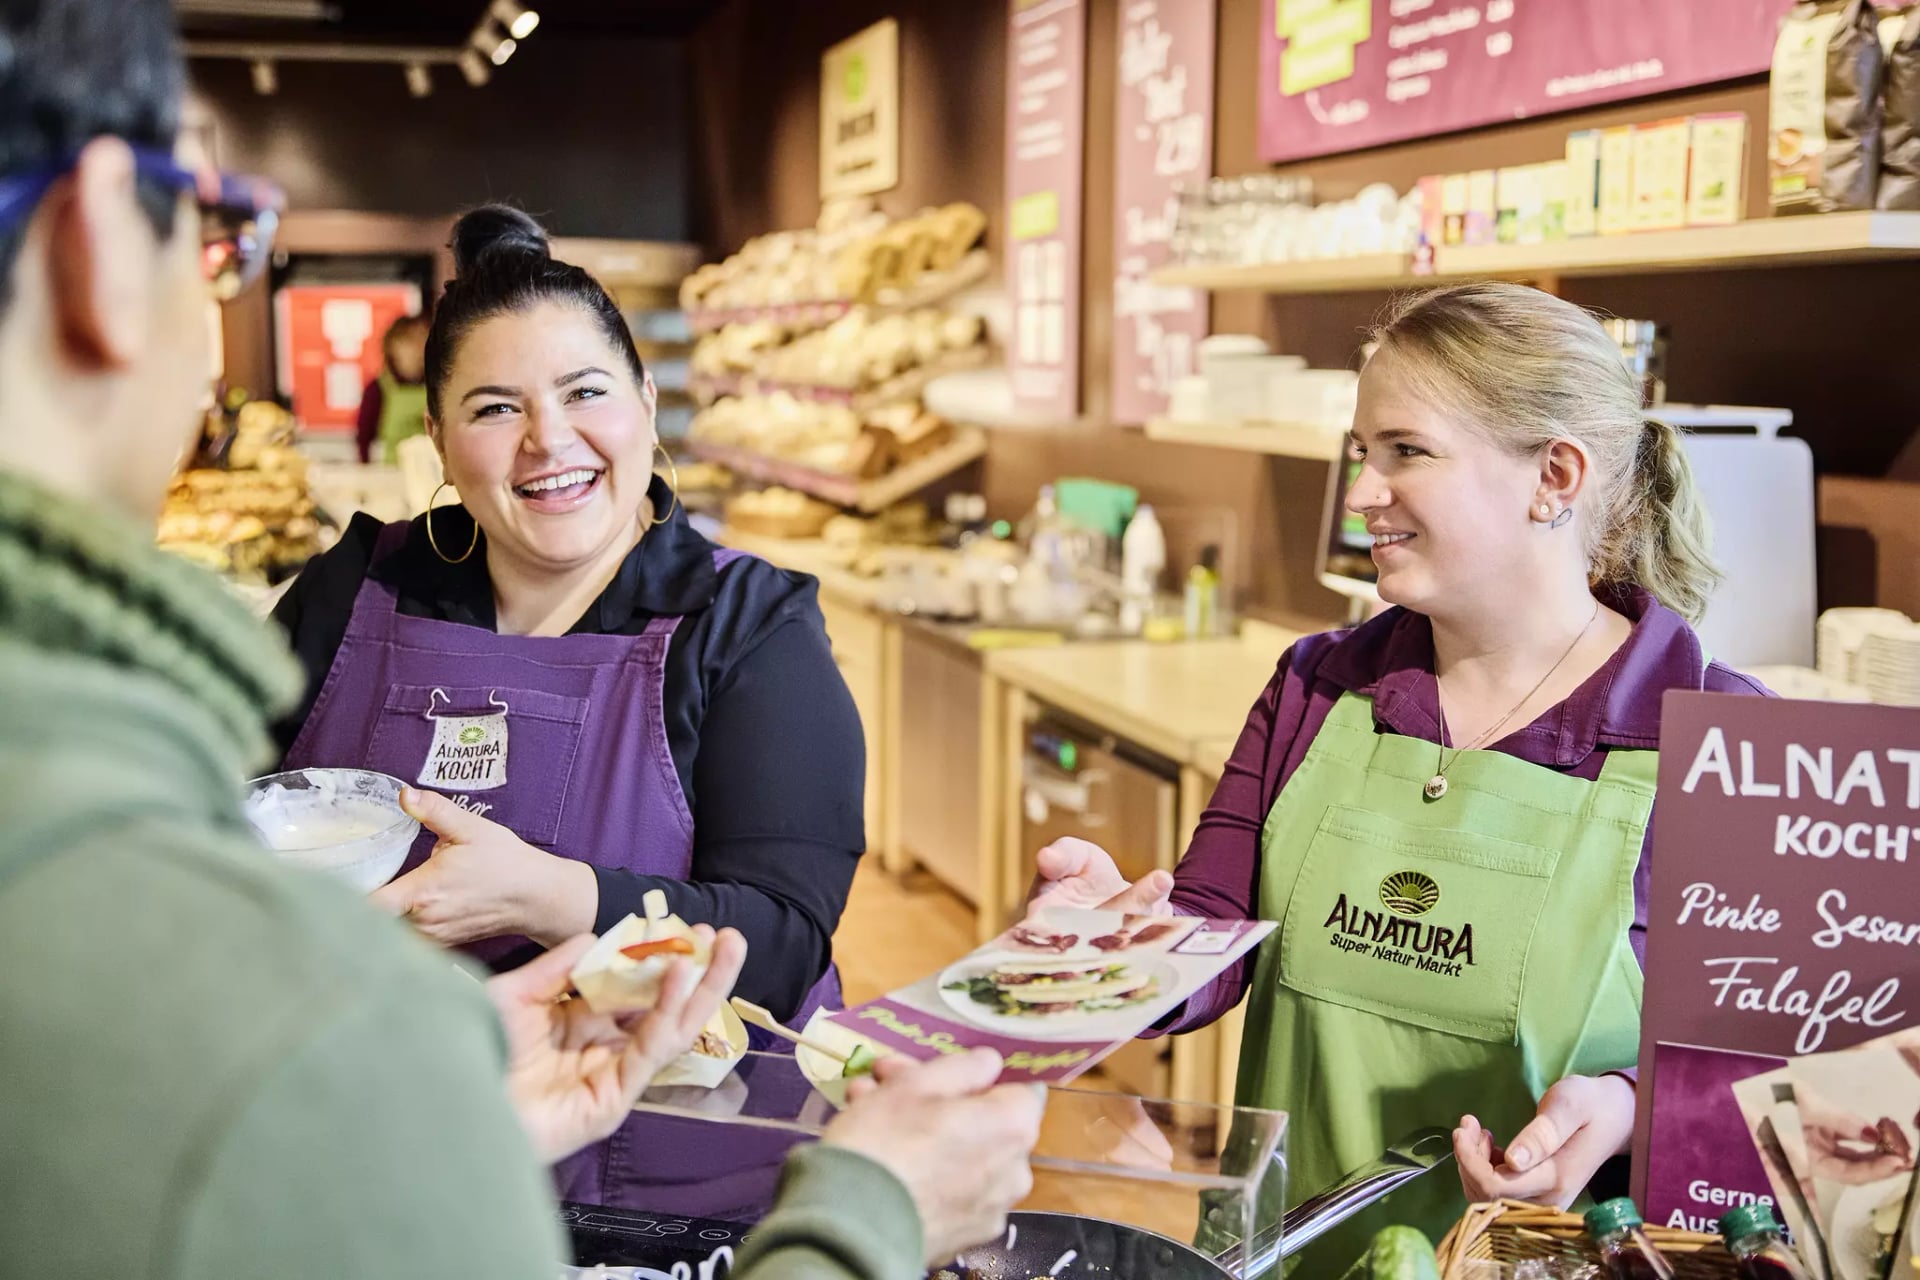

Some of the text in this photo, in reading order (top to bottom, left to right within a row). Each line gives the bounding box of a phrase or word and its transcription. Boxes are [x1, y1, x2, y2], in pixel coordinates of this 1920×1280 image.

[435, 740, 500, 759] ALNATURA
[435, 758, 497, 781] KOCHT
[1681, 726, 1920, 809] ALNAT
[1773, 814, 1920, 863] KOCH
[1323, 893, 1478, 966] ALNATURA
[1676, 882, 1781, 933] Pinke
[1330, 933, 1463, 977] Super Natur Markt
[1703, 956, 1907, 1055] Falafel
[1688, 1179, 1775, 1209] Gerne
